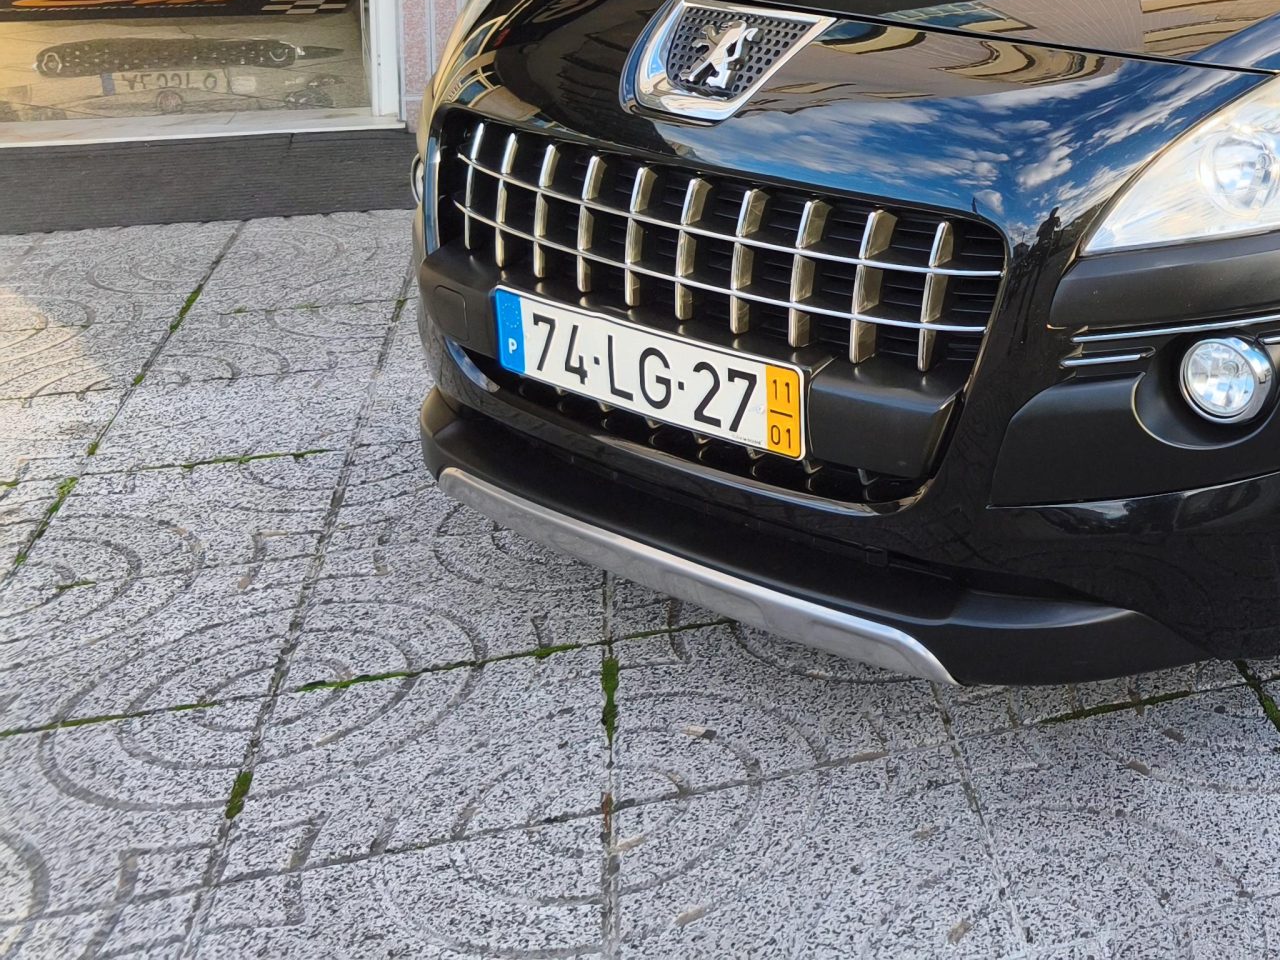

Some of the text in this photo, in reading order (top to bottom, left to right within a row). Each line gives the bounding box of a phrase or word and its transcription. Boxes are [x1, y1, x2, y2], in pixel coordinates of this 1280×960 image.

[508, 338, 518, 354] P
[771, 378, 792, 404] 11
[770, 424, 792, 449] 01
